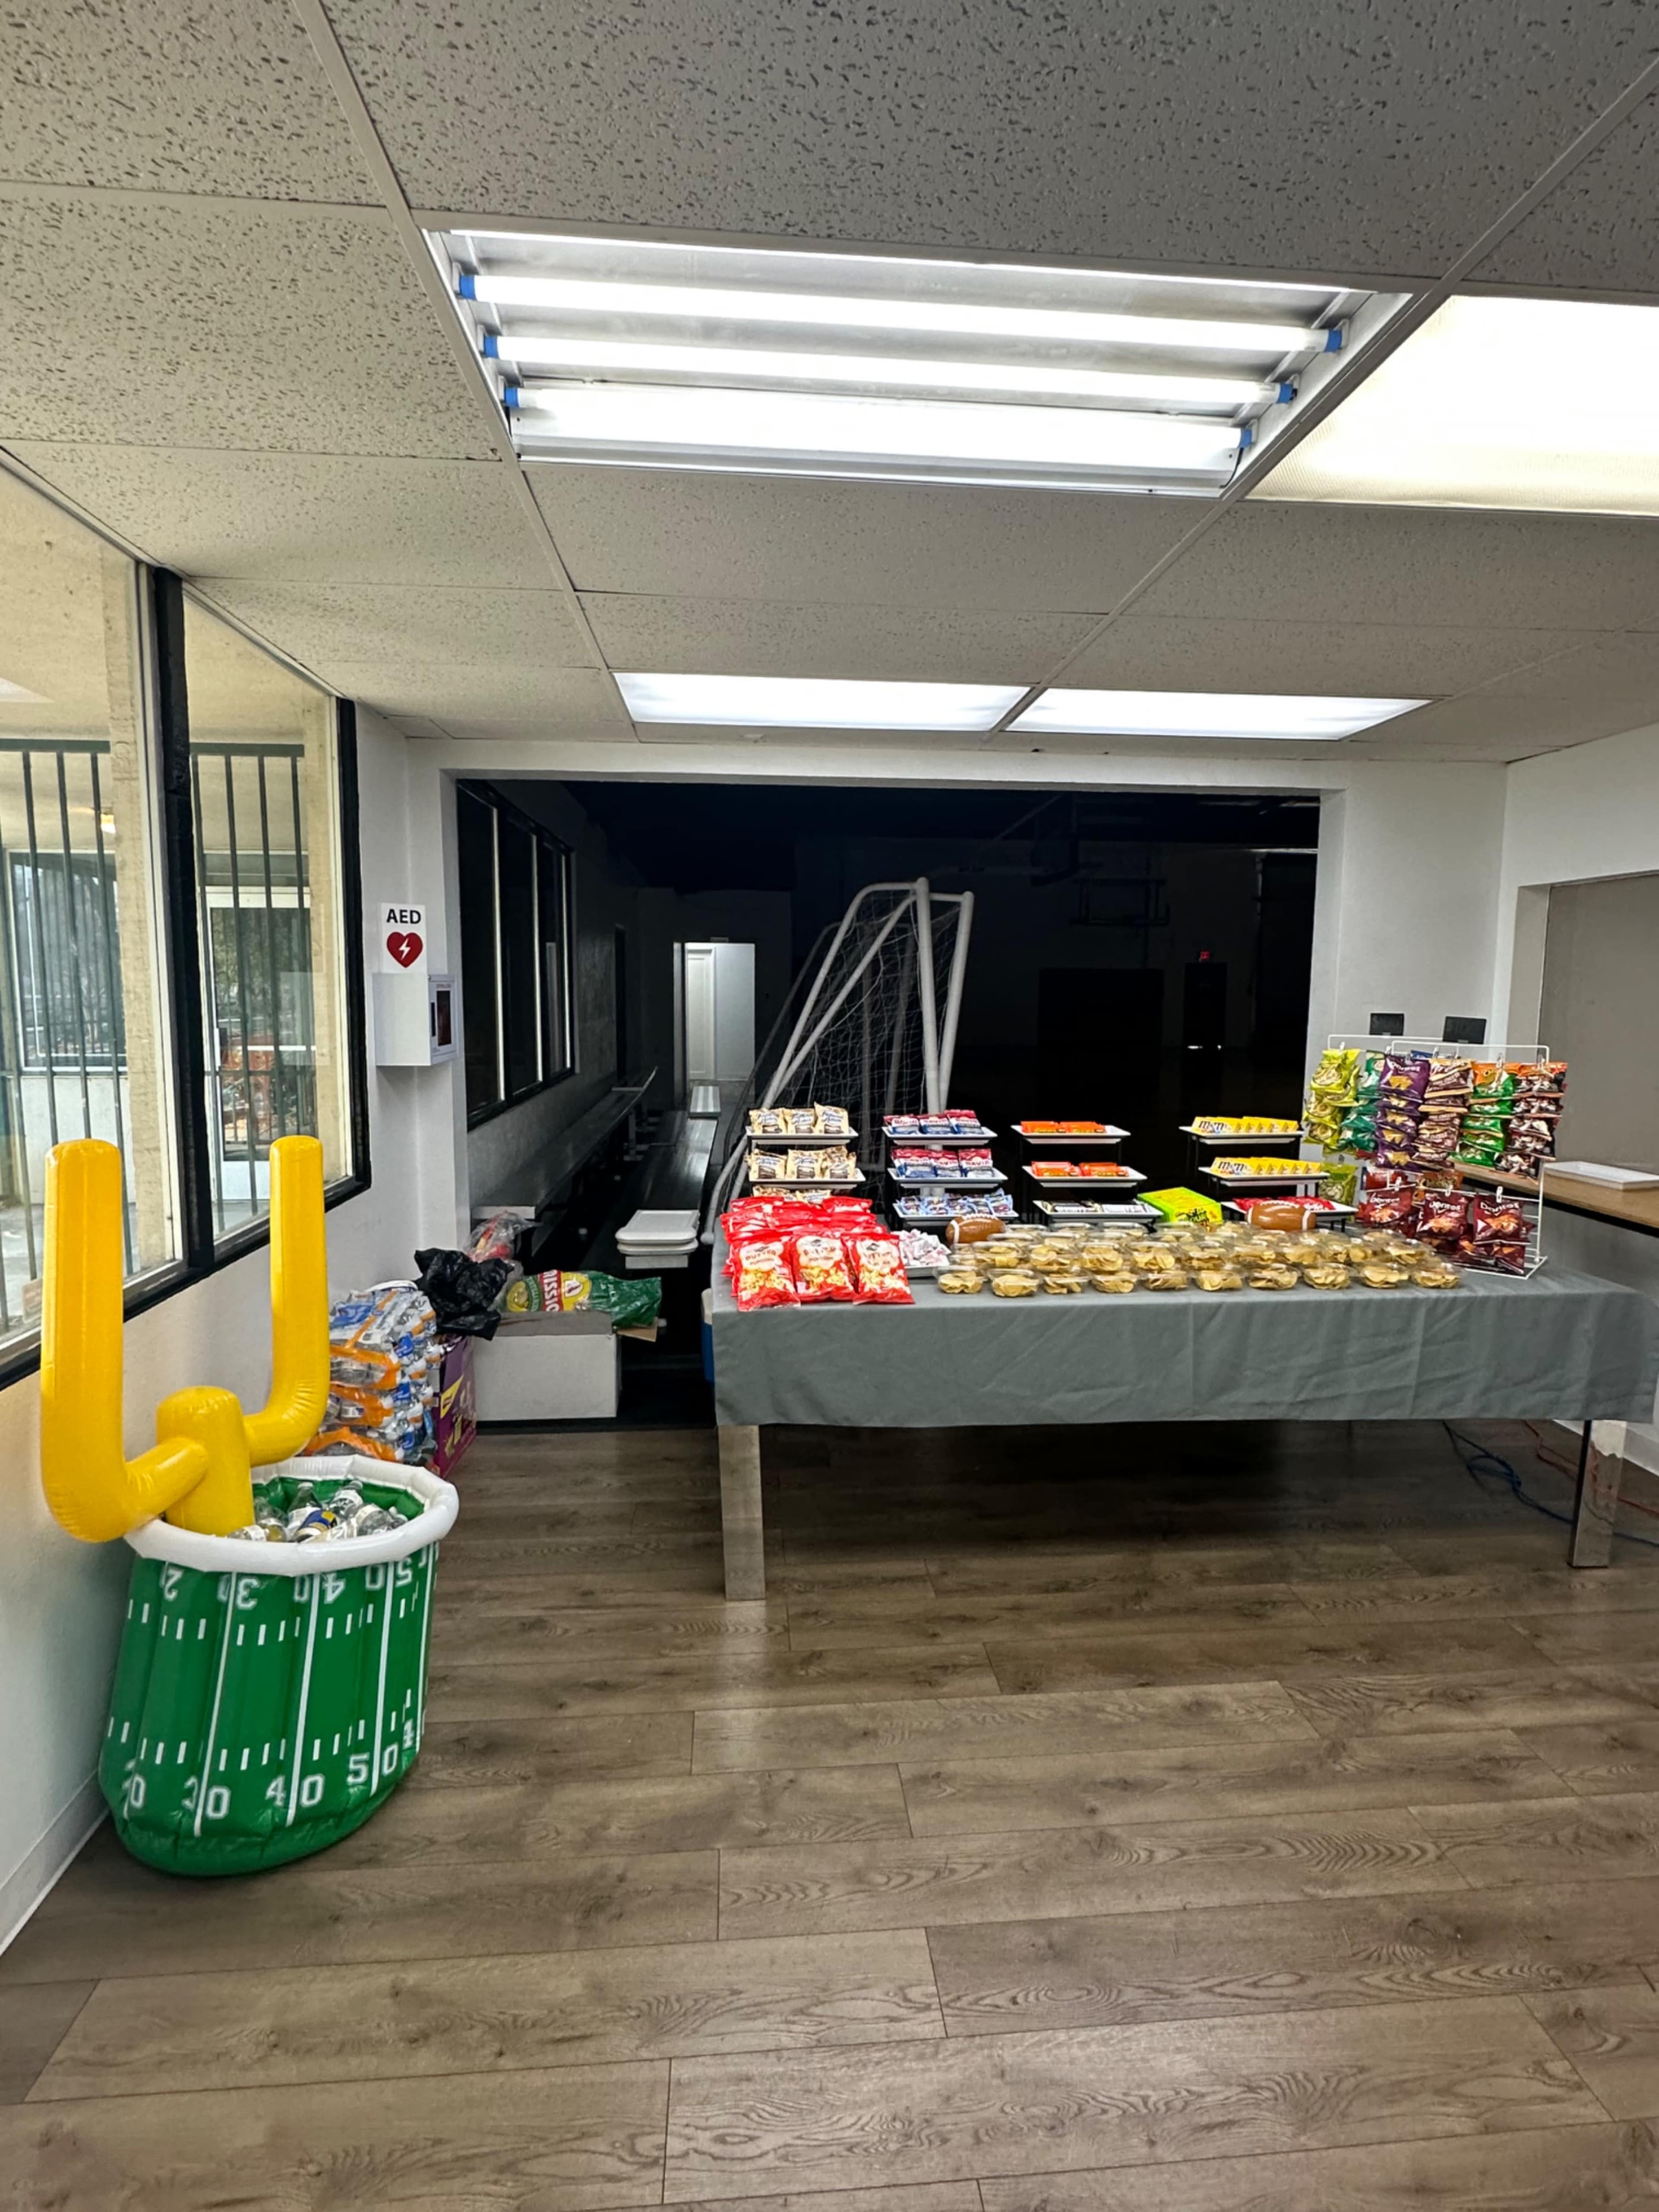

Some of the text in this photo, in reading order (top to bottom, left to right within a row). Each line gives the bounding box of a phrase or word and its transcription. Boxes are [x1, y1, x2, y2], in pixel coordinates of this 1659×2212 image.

[386, 909, 421, 924] AED
[347, 1742, 399, 1786] 50
[265, 1773, 325, 1808] 40
